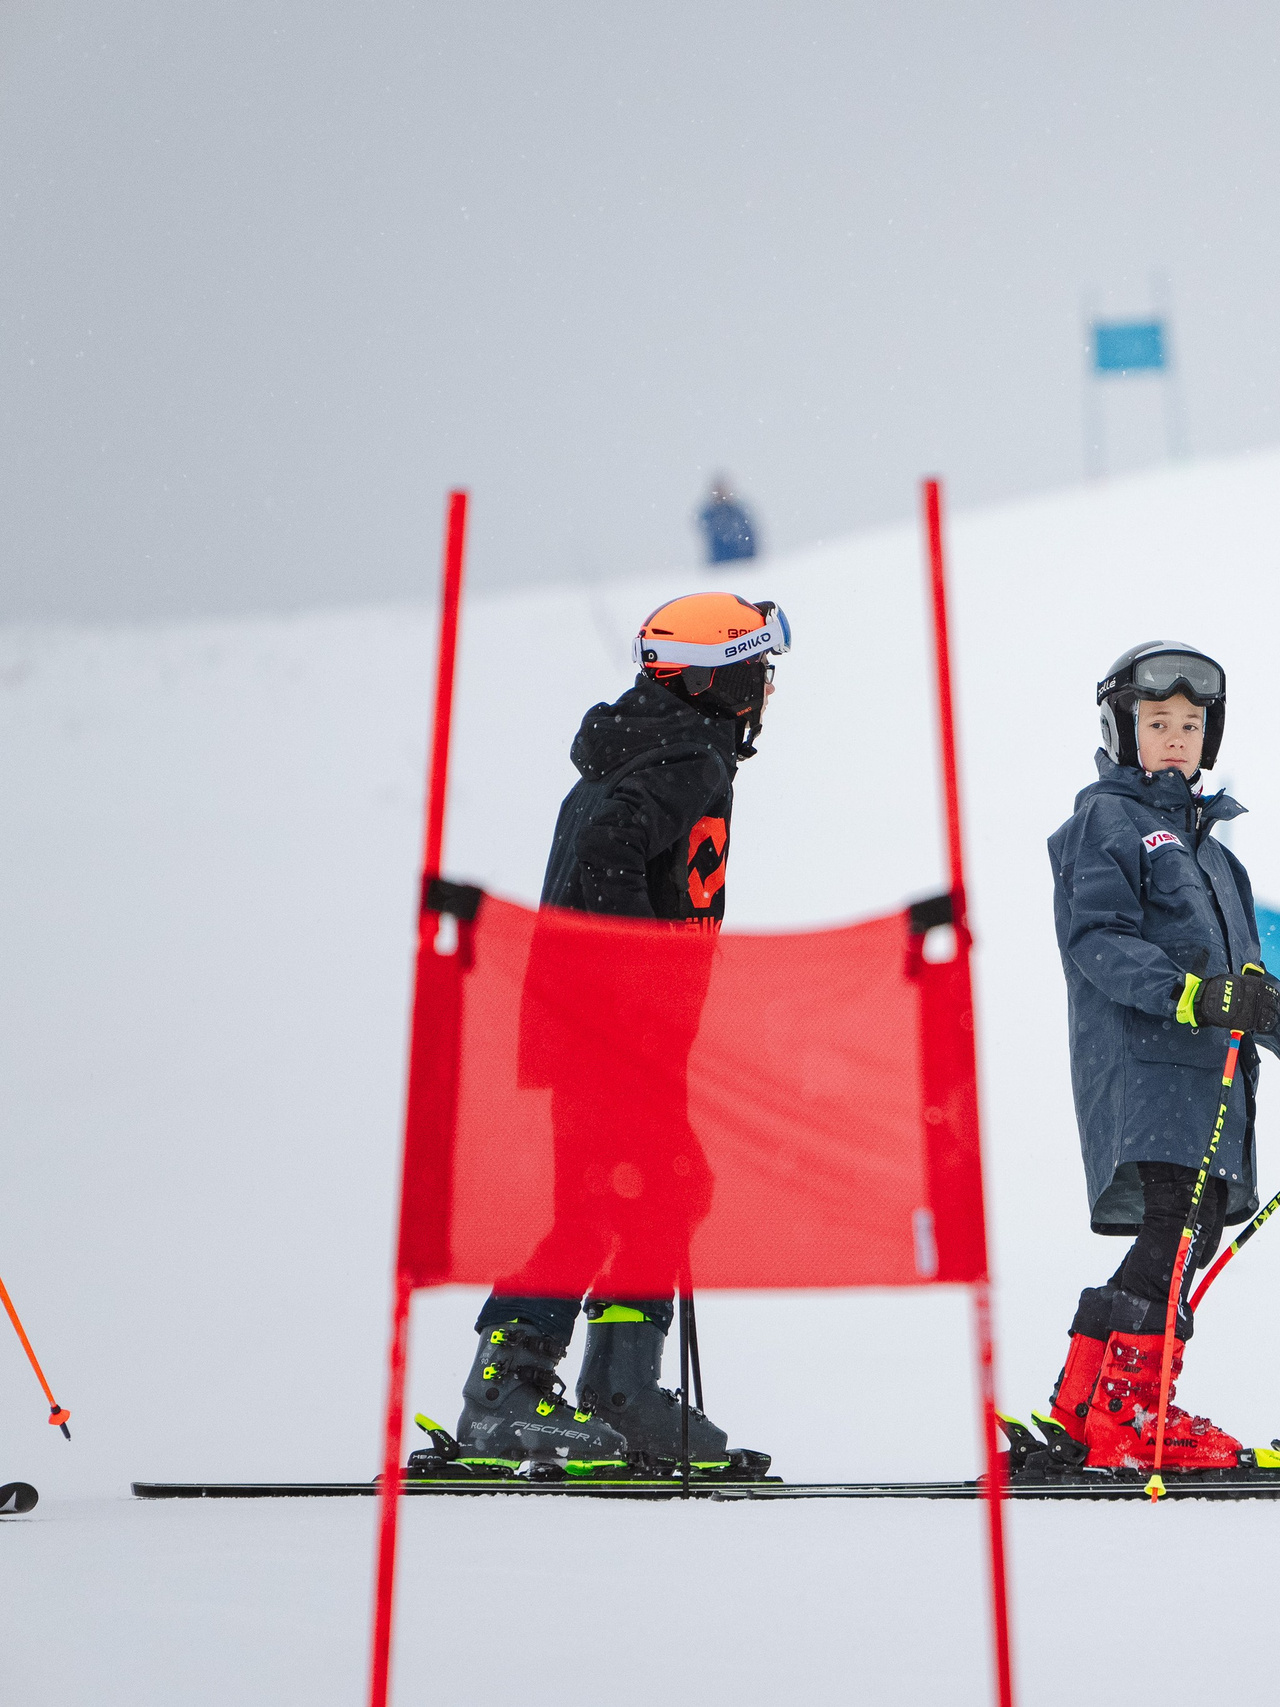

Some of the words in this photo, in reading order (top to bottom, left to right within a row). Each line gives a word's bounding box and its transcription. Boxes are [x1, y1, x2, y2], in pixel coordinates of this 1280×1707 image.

[725, 632, 771, 658] BRIKO
[1221, 980, 1234, 1013] LEKI
[470, 1421, 488, 1431] RC4
[509, 1420, 590, 1442] FISCHER
[1146, 1438, 1199, 1448] AOMIC
